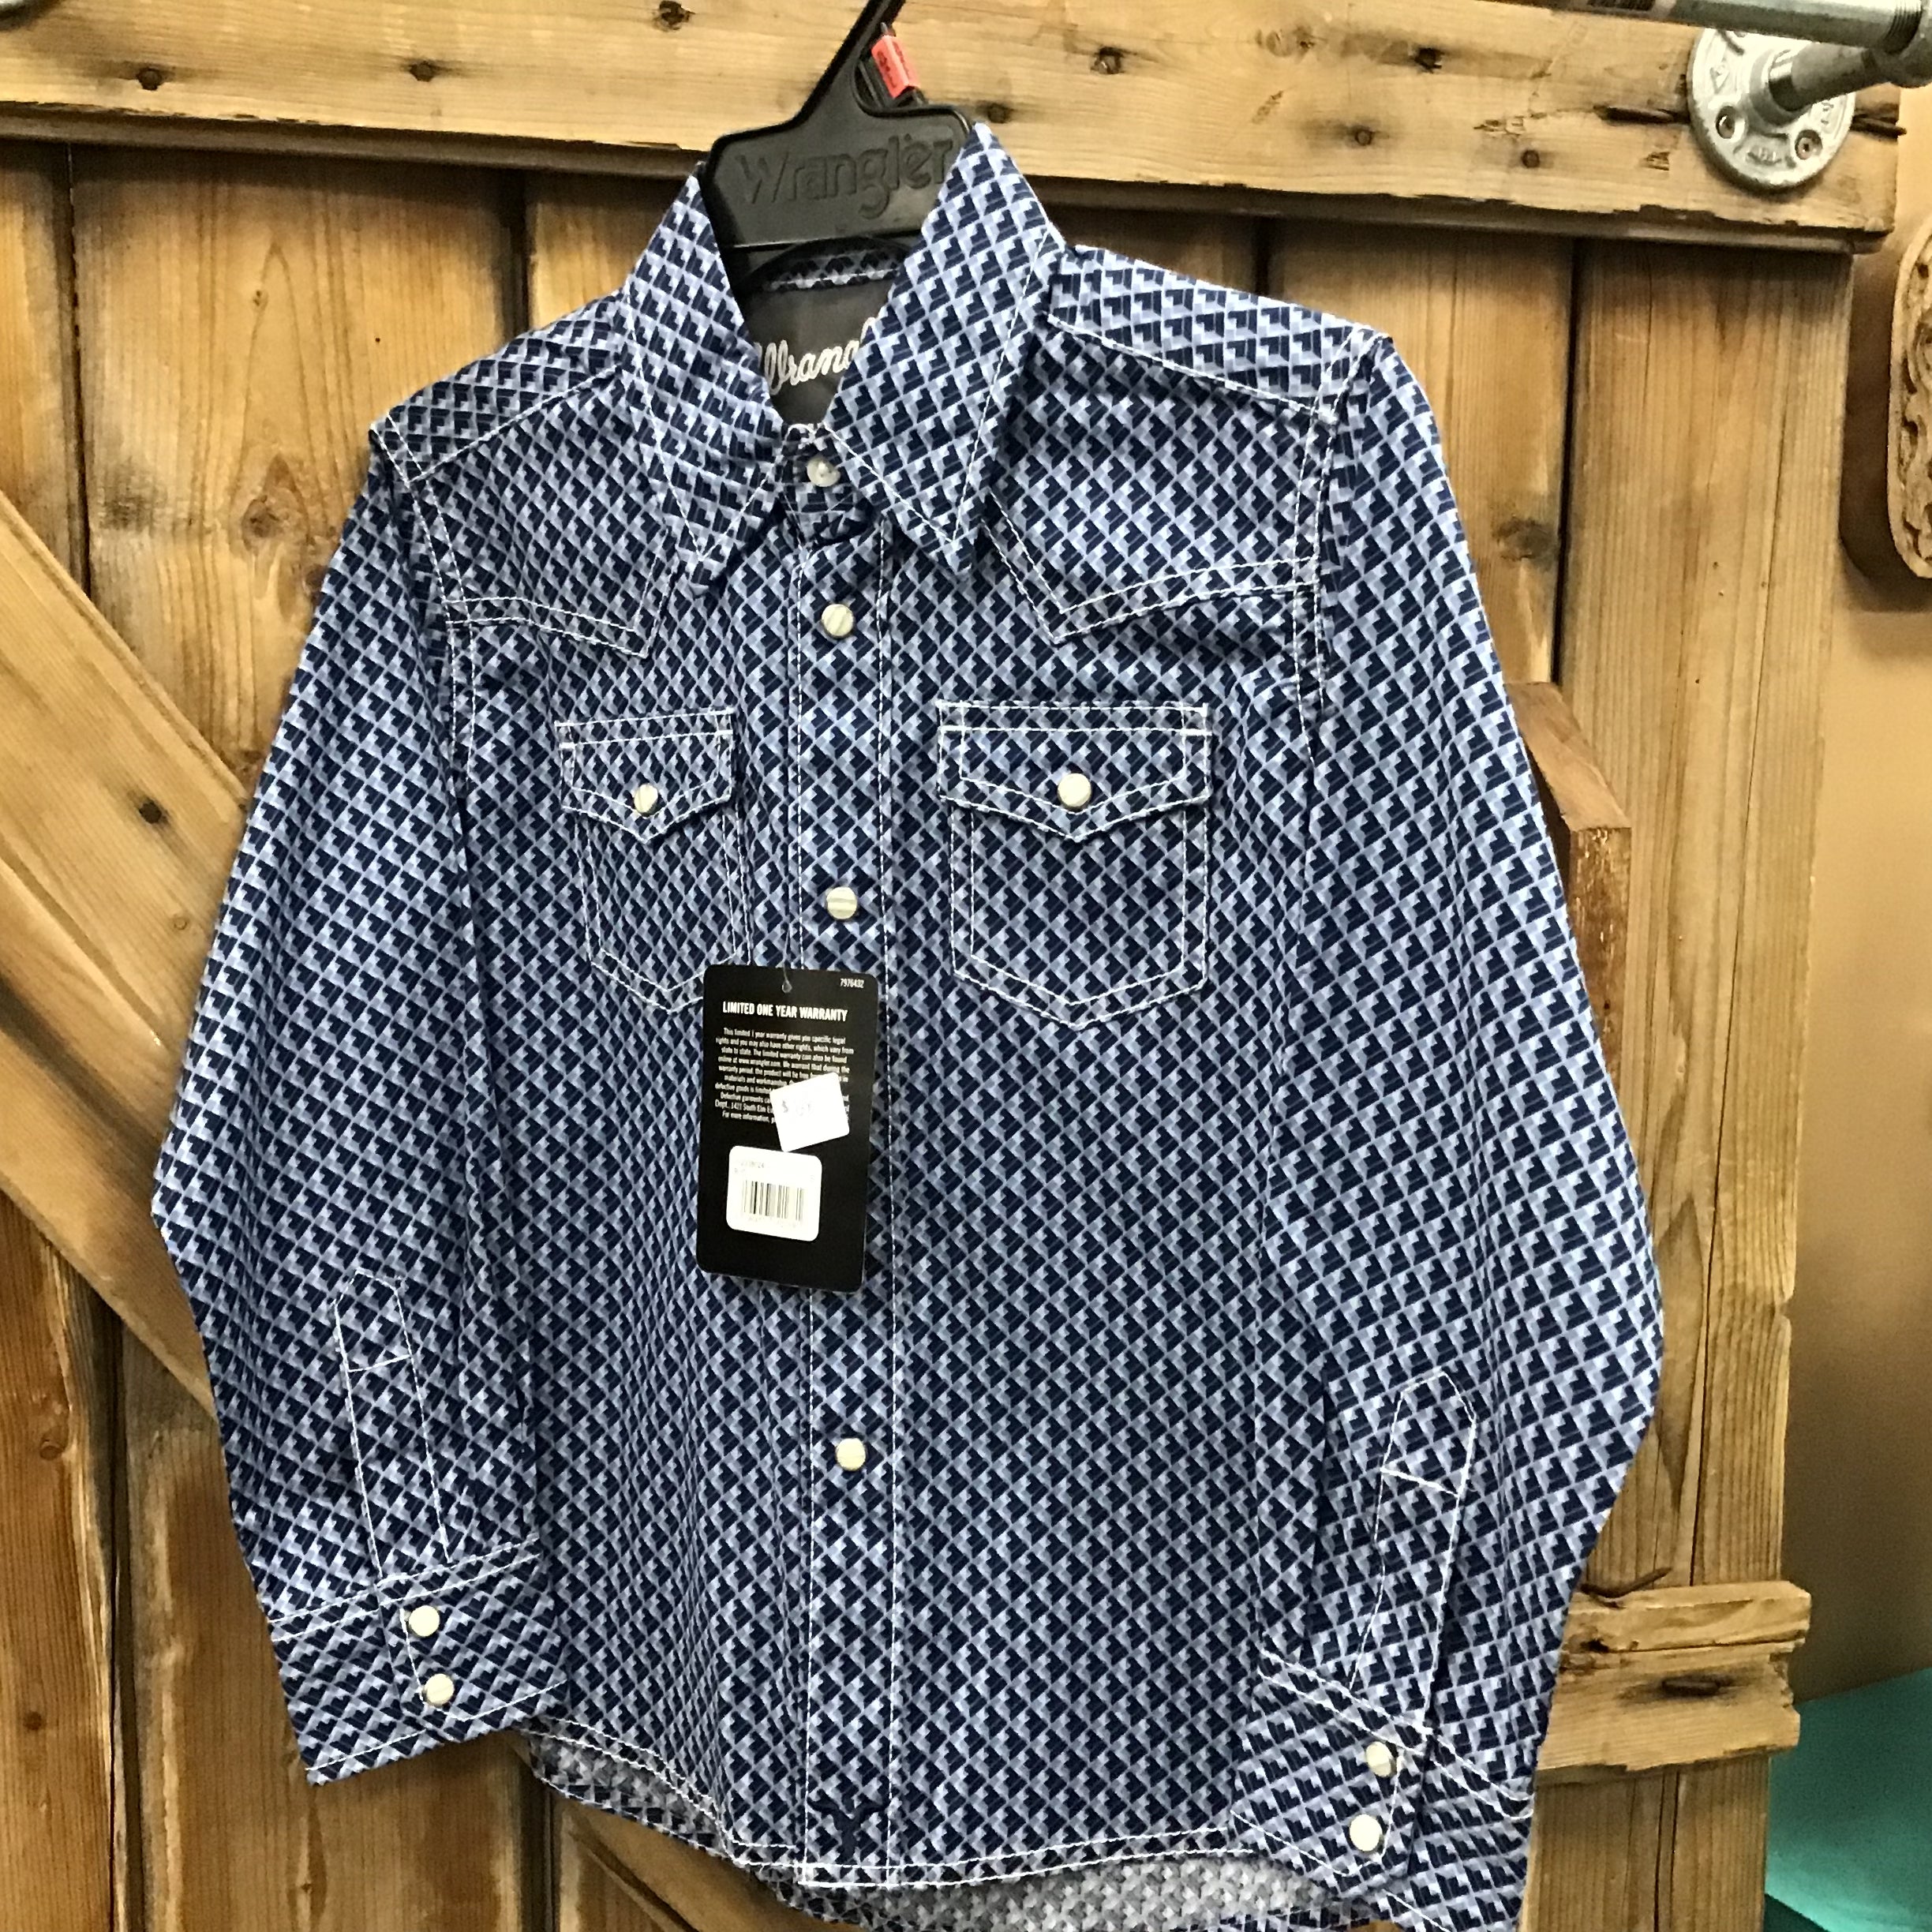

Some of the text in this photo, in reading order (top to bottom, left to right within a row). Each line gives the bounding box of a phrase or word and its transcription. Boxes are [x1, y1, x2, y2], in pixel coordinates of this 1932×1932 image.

[735, 133, 953, 219] Wrangler
[722, 1001, 848, 1022] LIMITED ONE YEAR WARRANTY
